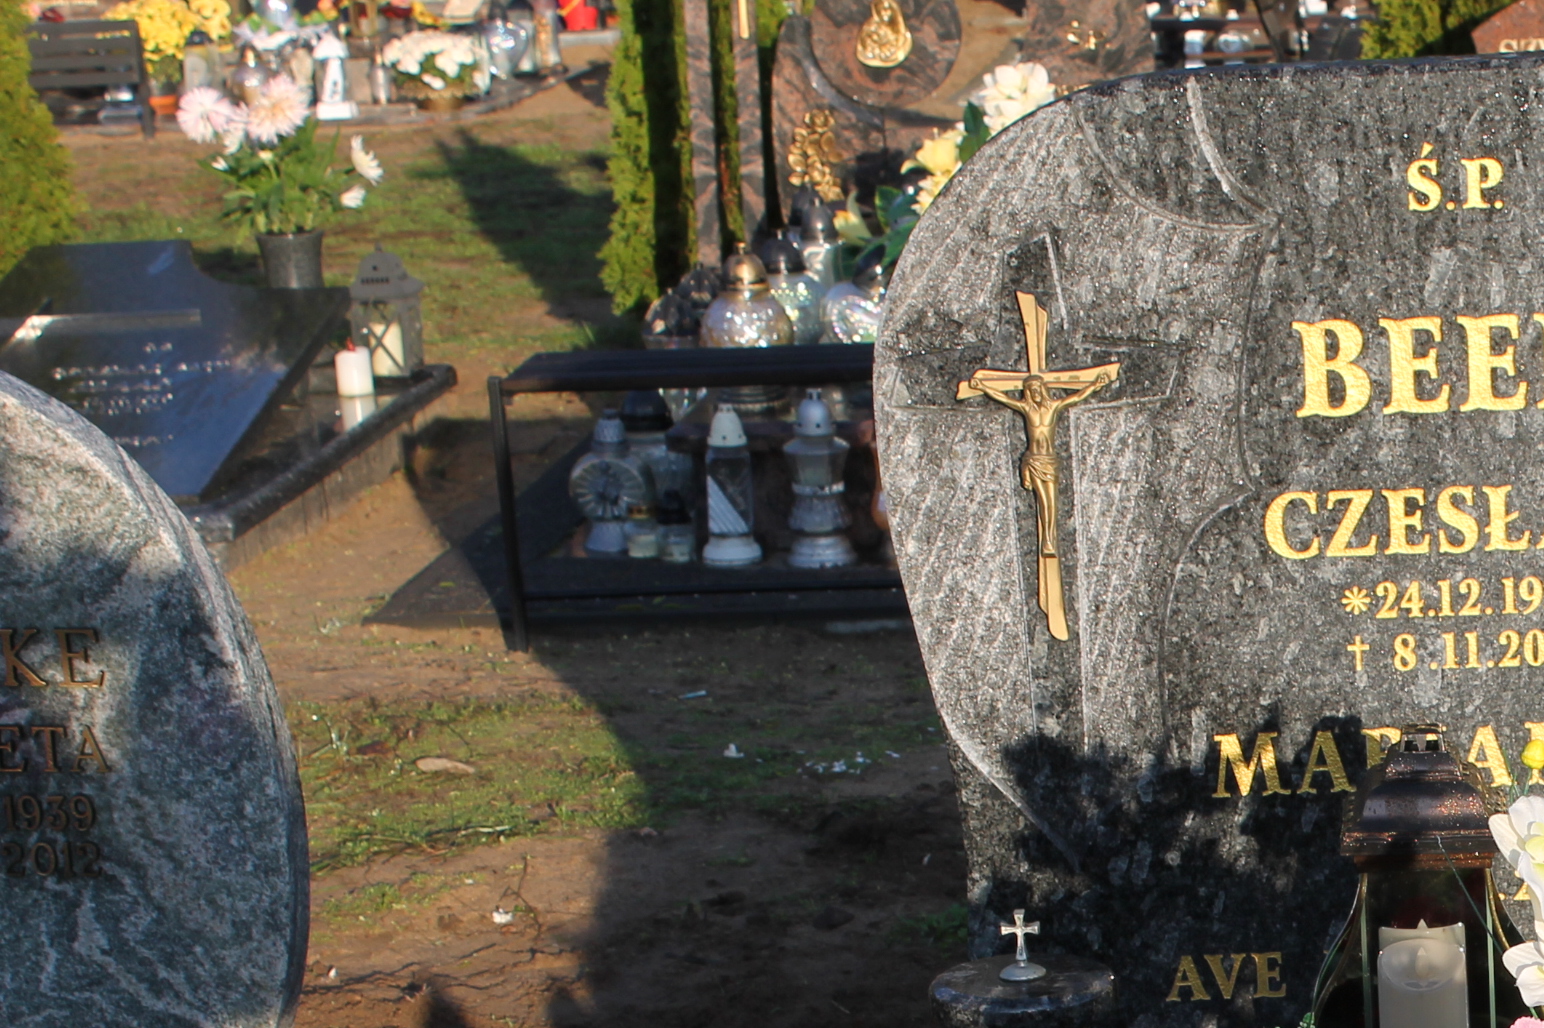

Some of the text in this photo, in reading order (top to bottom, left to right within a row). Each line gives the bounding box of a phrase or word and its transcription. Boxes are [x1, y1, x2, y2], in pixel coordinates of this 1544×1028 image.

[1406, 142, 1504, 212] Ś.P.
[3, 794, 95, 831] 1939
[2, 842, 102, 878] 2012
[1166, 951, 1288, 1002] AVE
